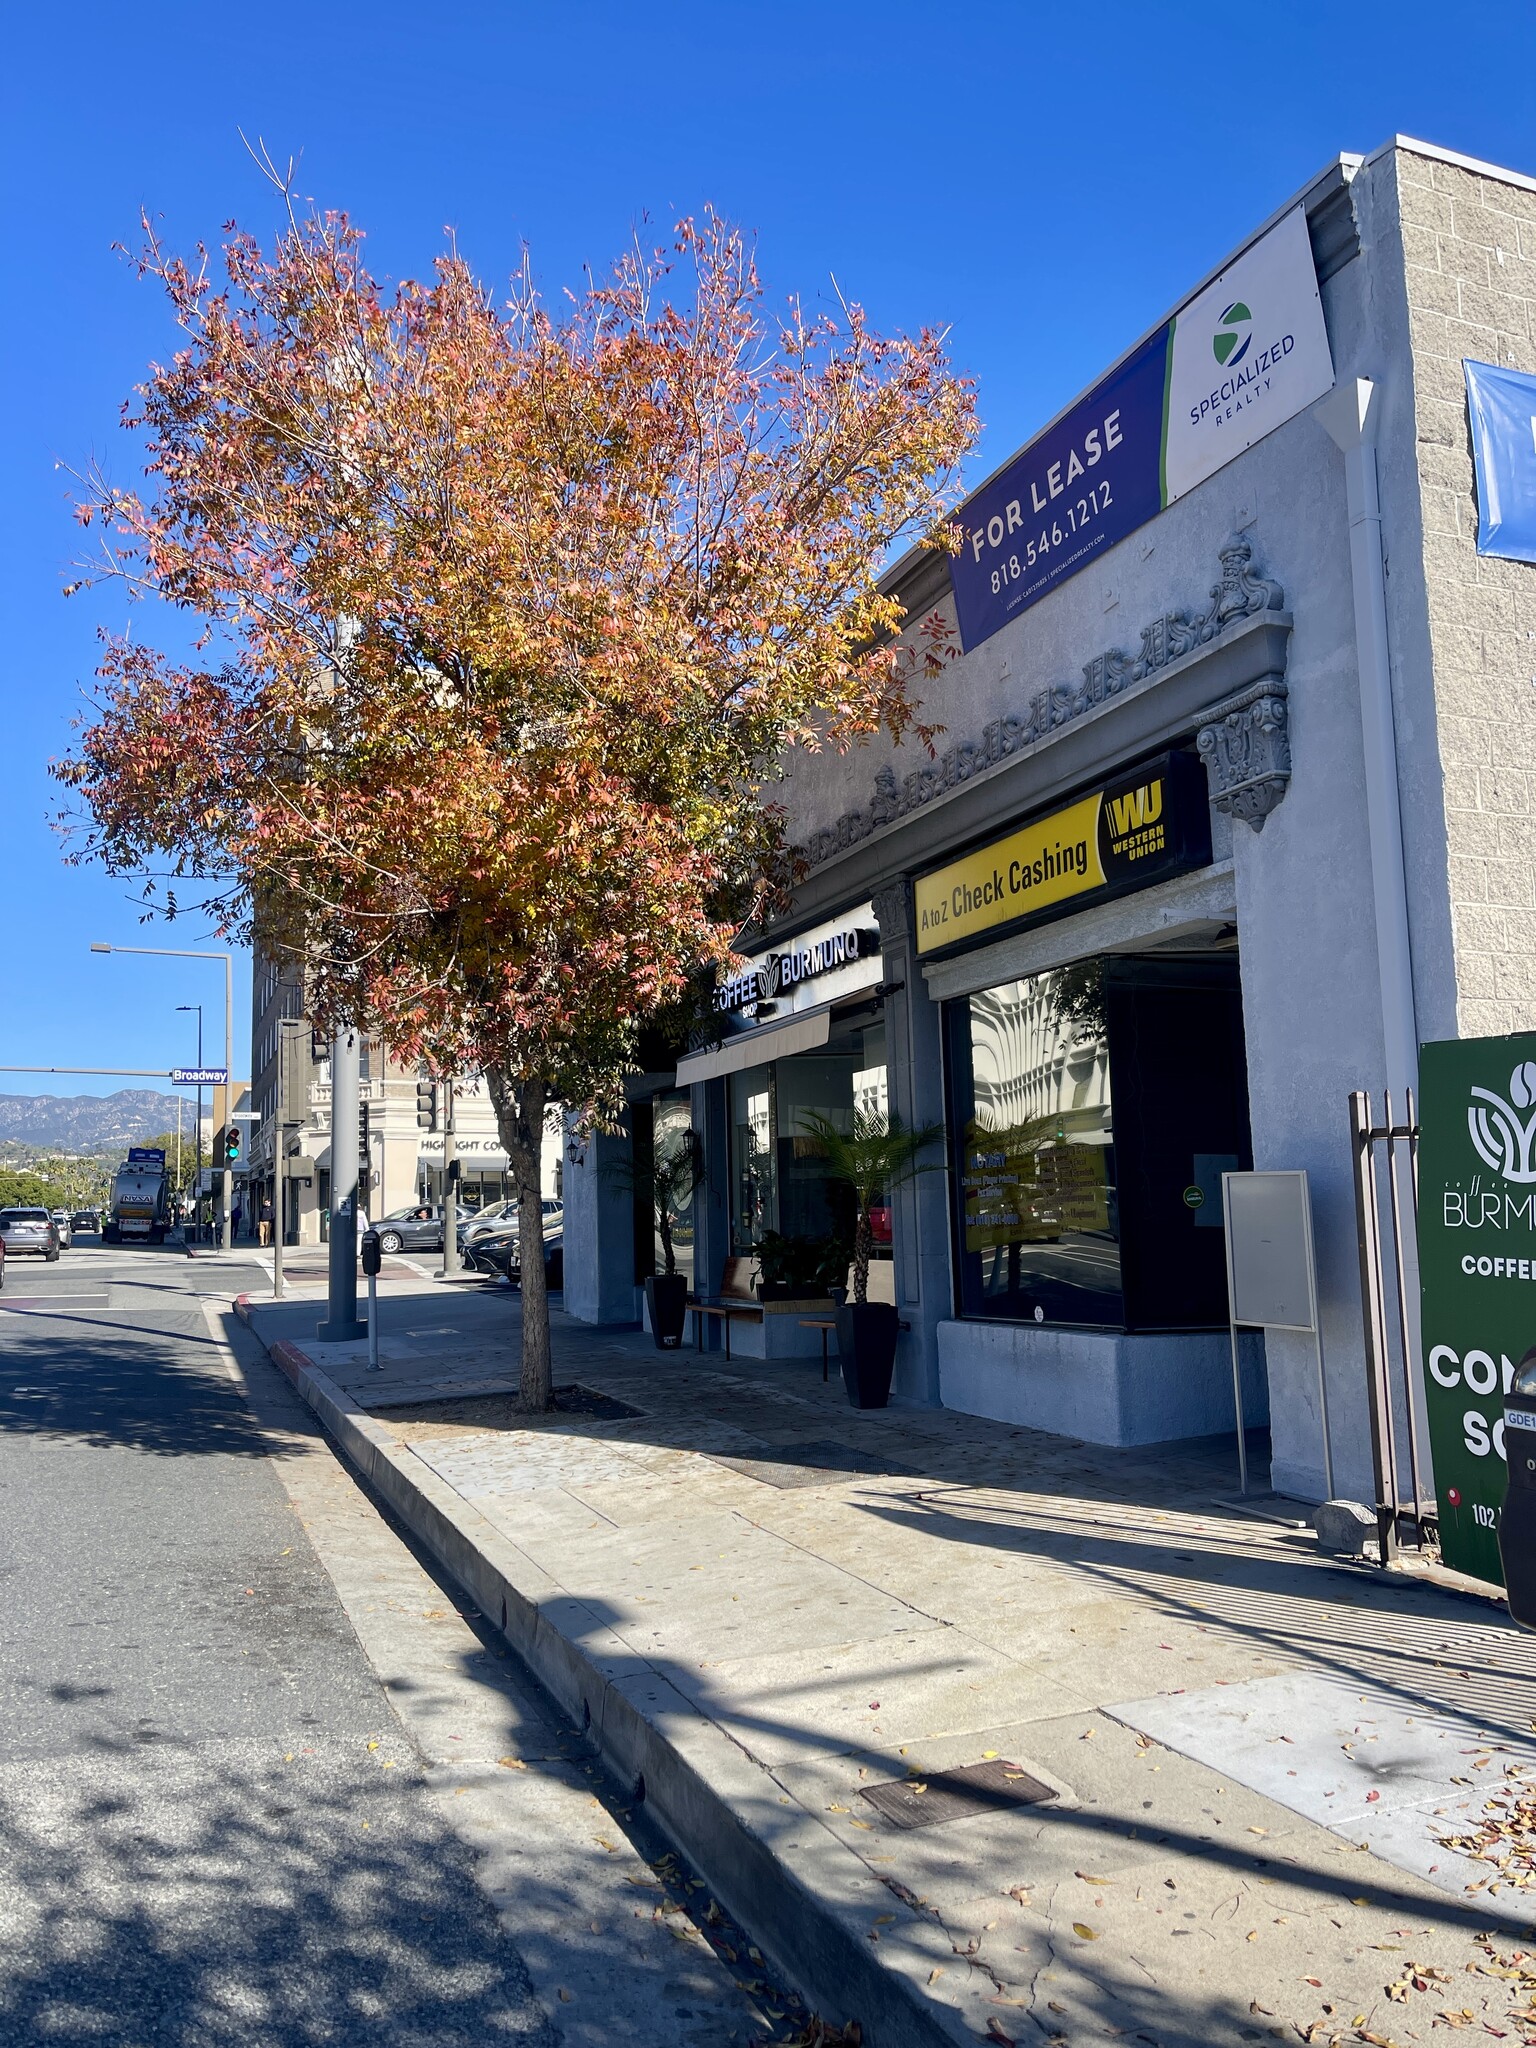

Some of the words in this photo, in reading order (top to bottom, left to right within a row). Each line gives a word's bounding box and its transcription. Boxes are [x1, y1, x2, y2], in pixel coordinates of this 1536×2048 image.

[1190, 334, 1295, 426] SPECIALIZED
[1215, 377, 1271, 427] REALTY
[971, 499, 1024, 563] FOR
[1030, 408, 1124, 514] LEASE
[990, 480, 1113, 595] 818.546.1212
[1112, 824, 1164, 855] WESTERN
[1128, 840, 1165, 861] UNION
[921, 909, 930, 931] A
[930, 910, 941, 926] to
[941, 901, 949, 923] Z
[952, 869, 1005, 918] Check
[1008, 840, 1088, 895] Cashing
[781, 927, 860, 987] BURMUNQ
[742, 1002, 758, 1019] SHOP
[174, 1069, 228, 1084] Broadway
[1445, 1174, 1508, 1197] coffee
[1443, 1191, 1536, 1231] BURM
[1471, 1503, 1497, 1530] 102
